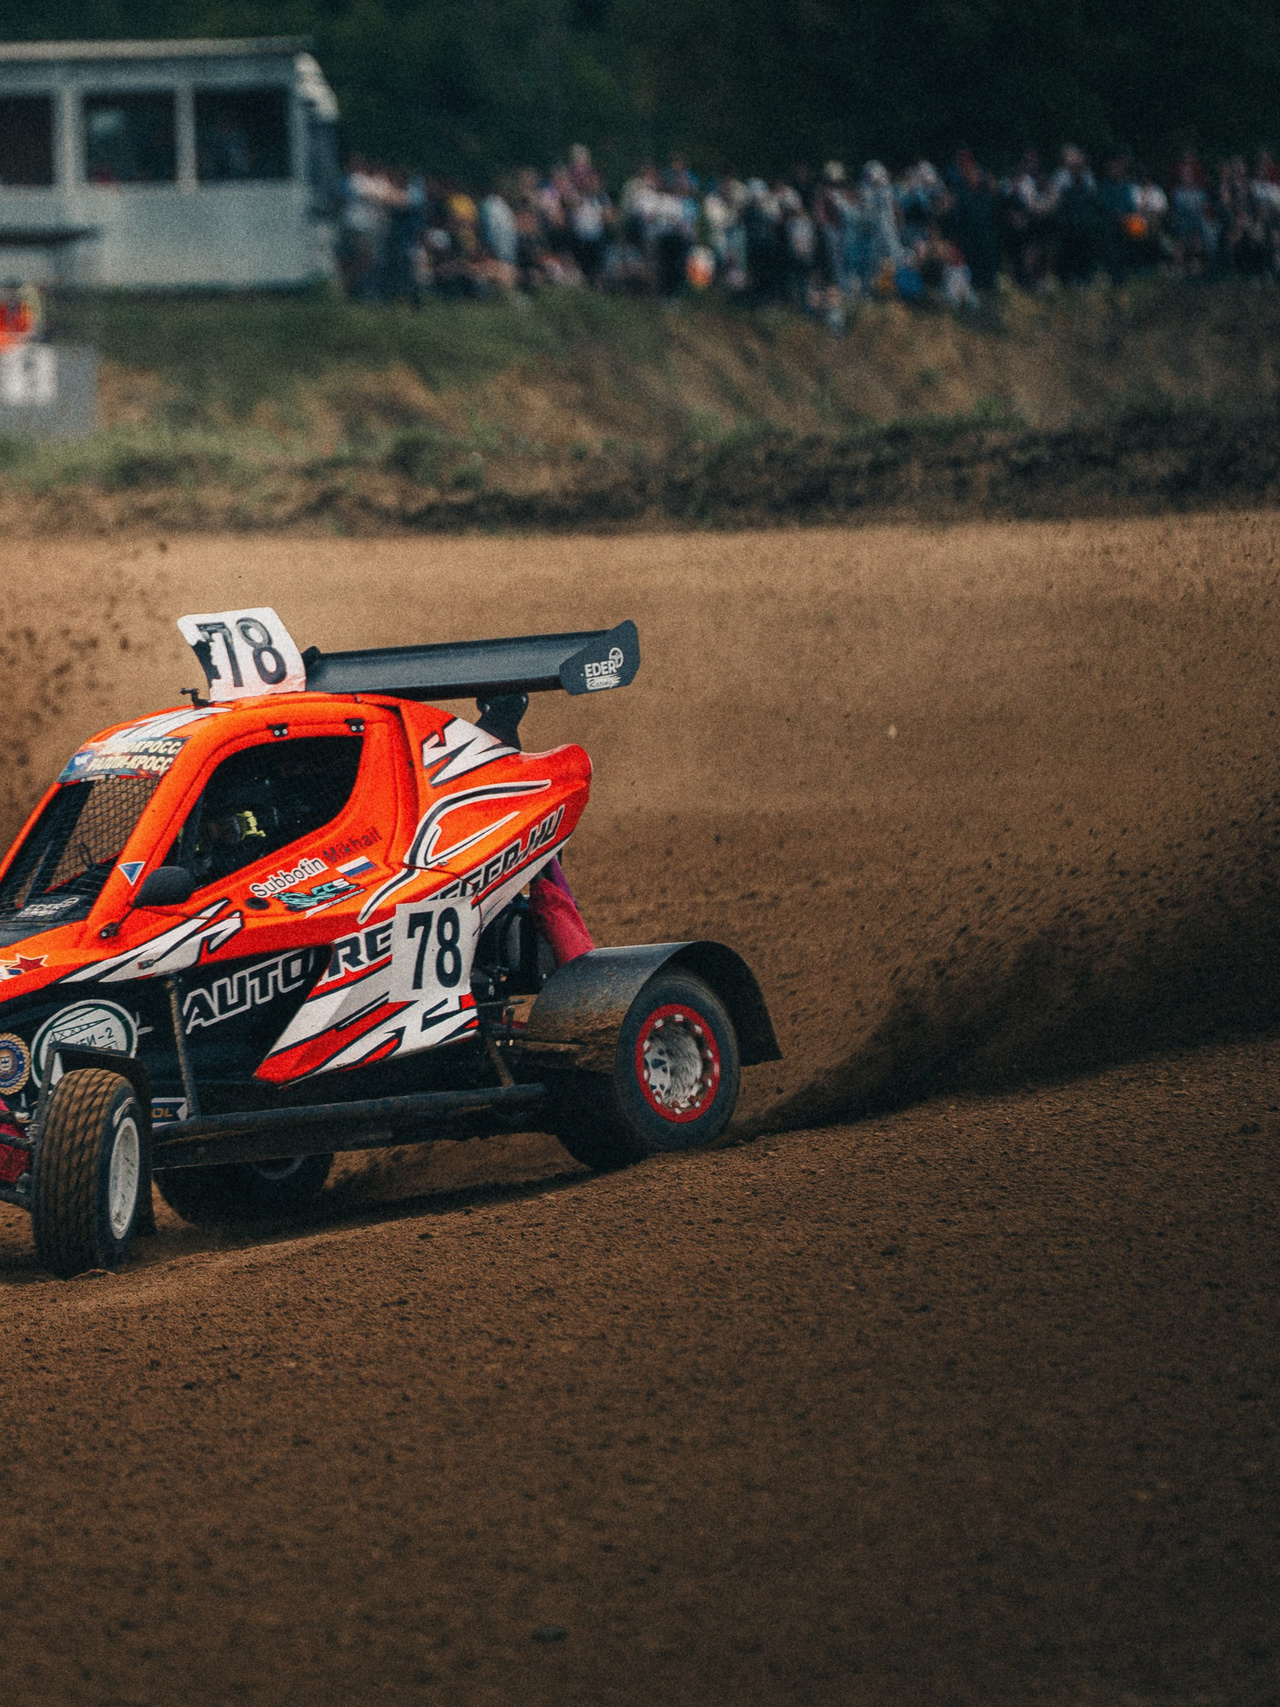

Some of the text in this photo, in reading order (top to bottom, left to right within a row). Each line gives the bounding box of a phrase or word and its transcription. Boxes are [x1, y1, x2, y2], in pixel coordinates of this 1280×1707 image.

[196, 617, 287, 688] 78
[584, 660, 618, 677] EDER
[250, 826, 382, 897] Subbotin Mikhail
[406, 906, 463, 991] 78
[151, 1106, 174, 1119] OL
